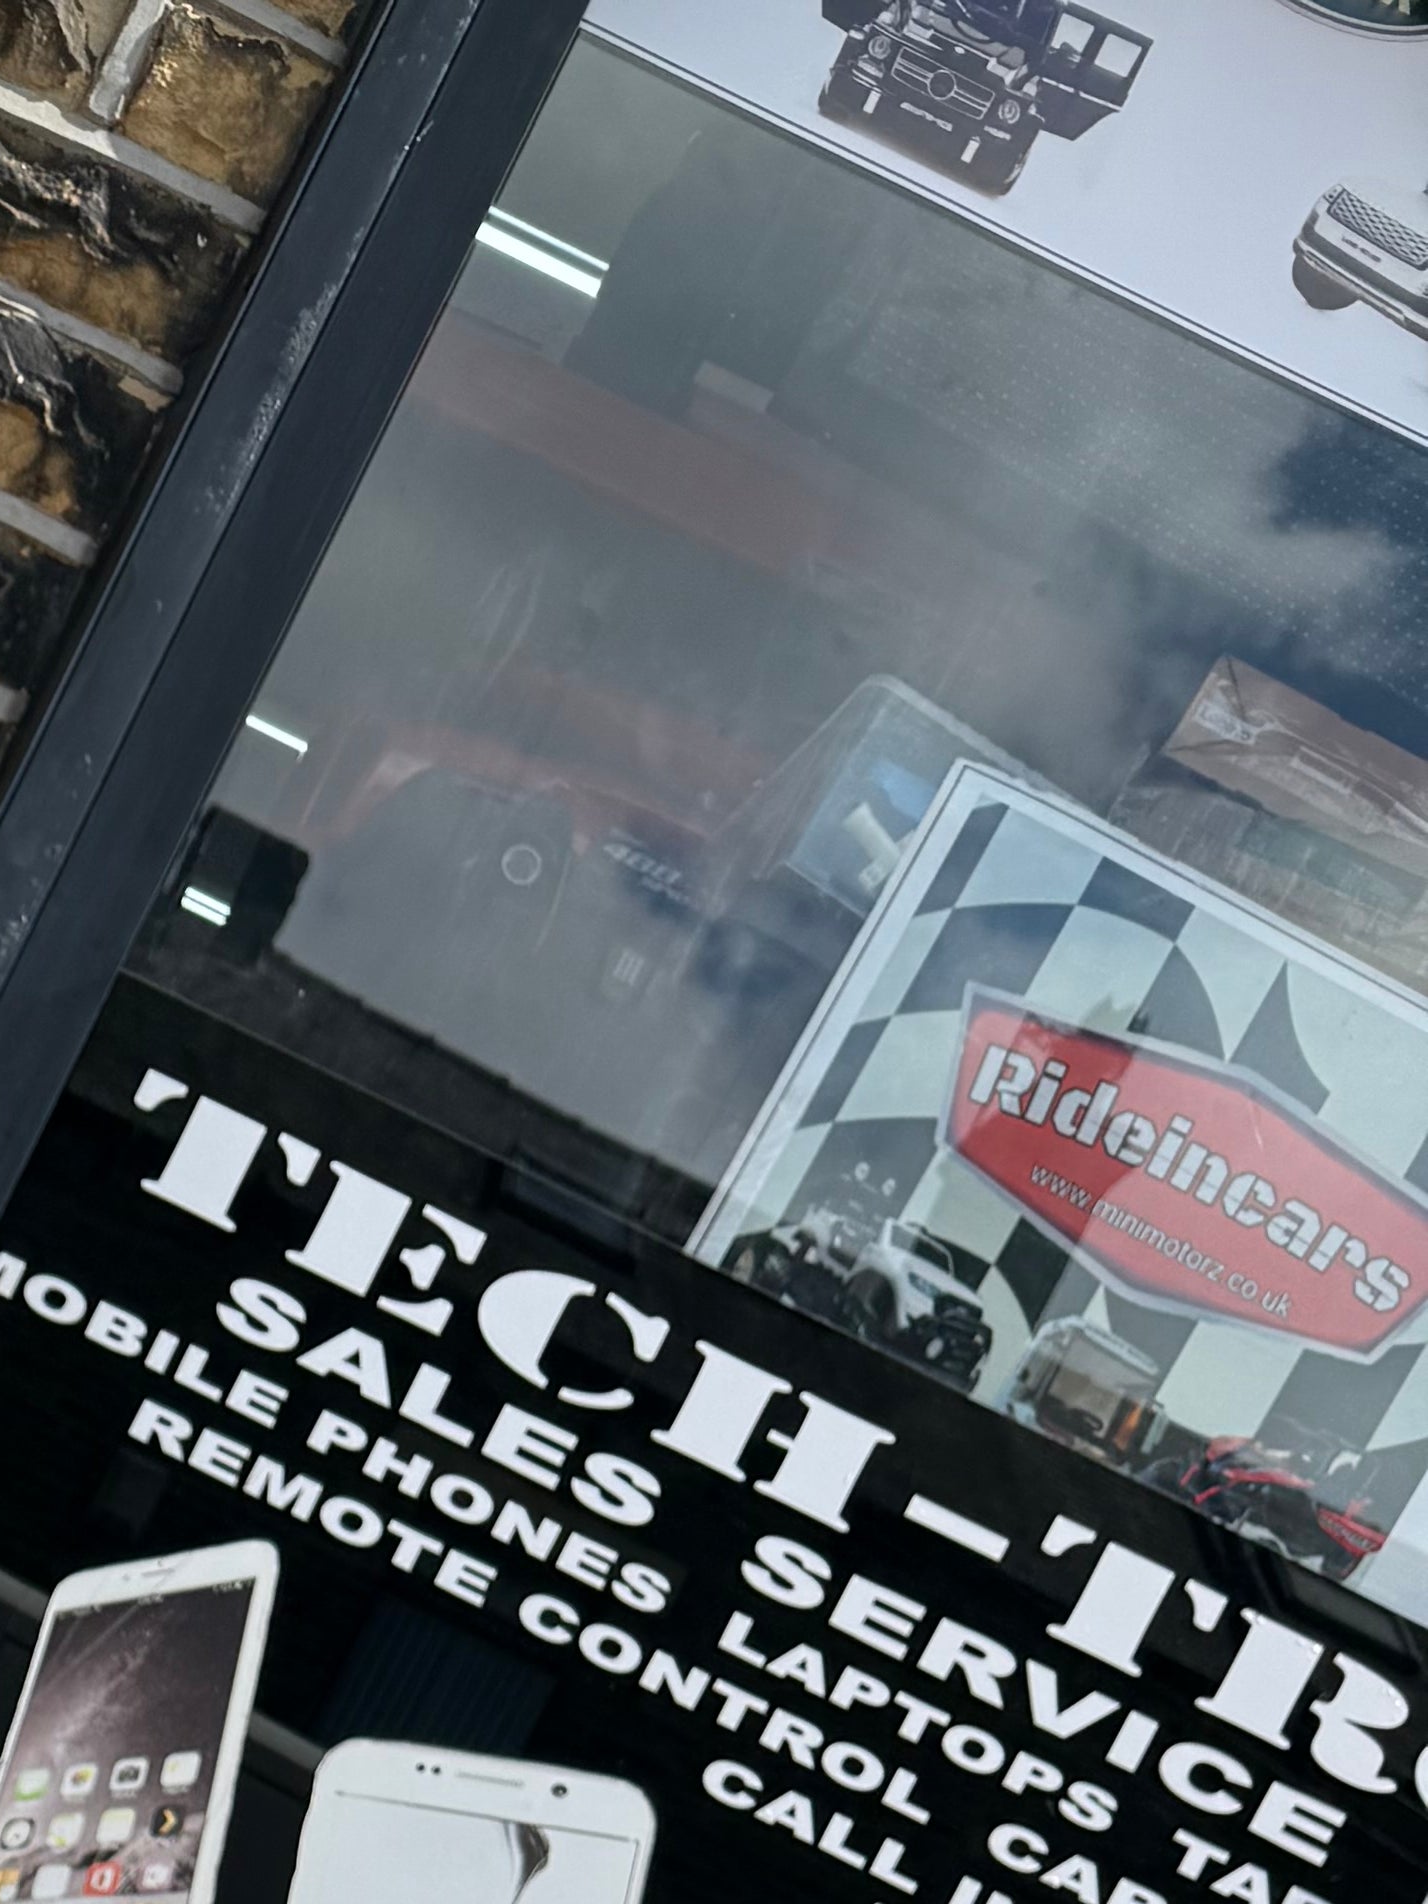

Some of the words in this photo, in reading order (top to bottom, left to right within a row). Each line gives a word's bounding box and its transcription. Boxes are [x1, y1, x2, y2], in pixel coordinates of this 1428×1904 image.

[969, 1044, 1412, 1312] Rideincars
[128, 1398, 498, 1608] REMOTE
[519, 1594, 932, 1825] CONTROL
[134, 1068, 1428, 1808] TECH-TR
[216, 1278, 662, 1526] SALES
[741, 1535, 1347, 1867] SERVICE
[307, 1409, 672, 1613] PHONES
[718, 1611, 1119, 1832] LAPTOPS
[702, 1759, 919, 1894] CALL
